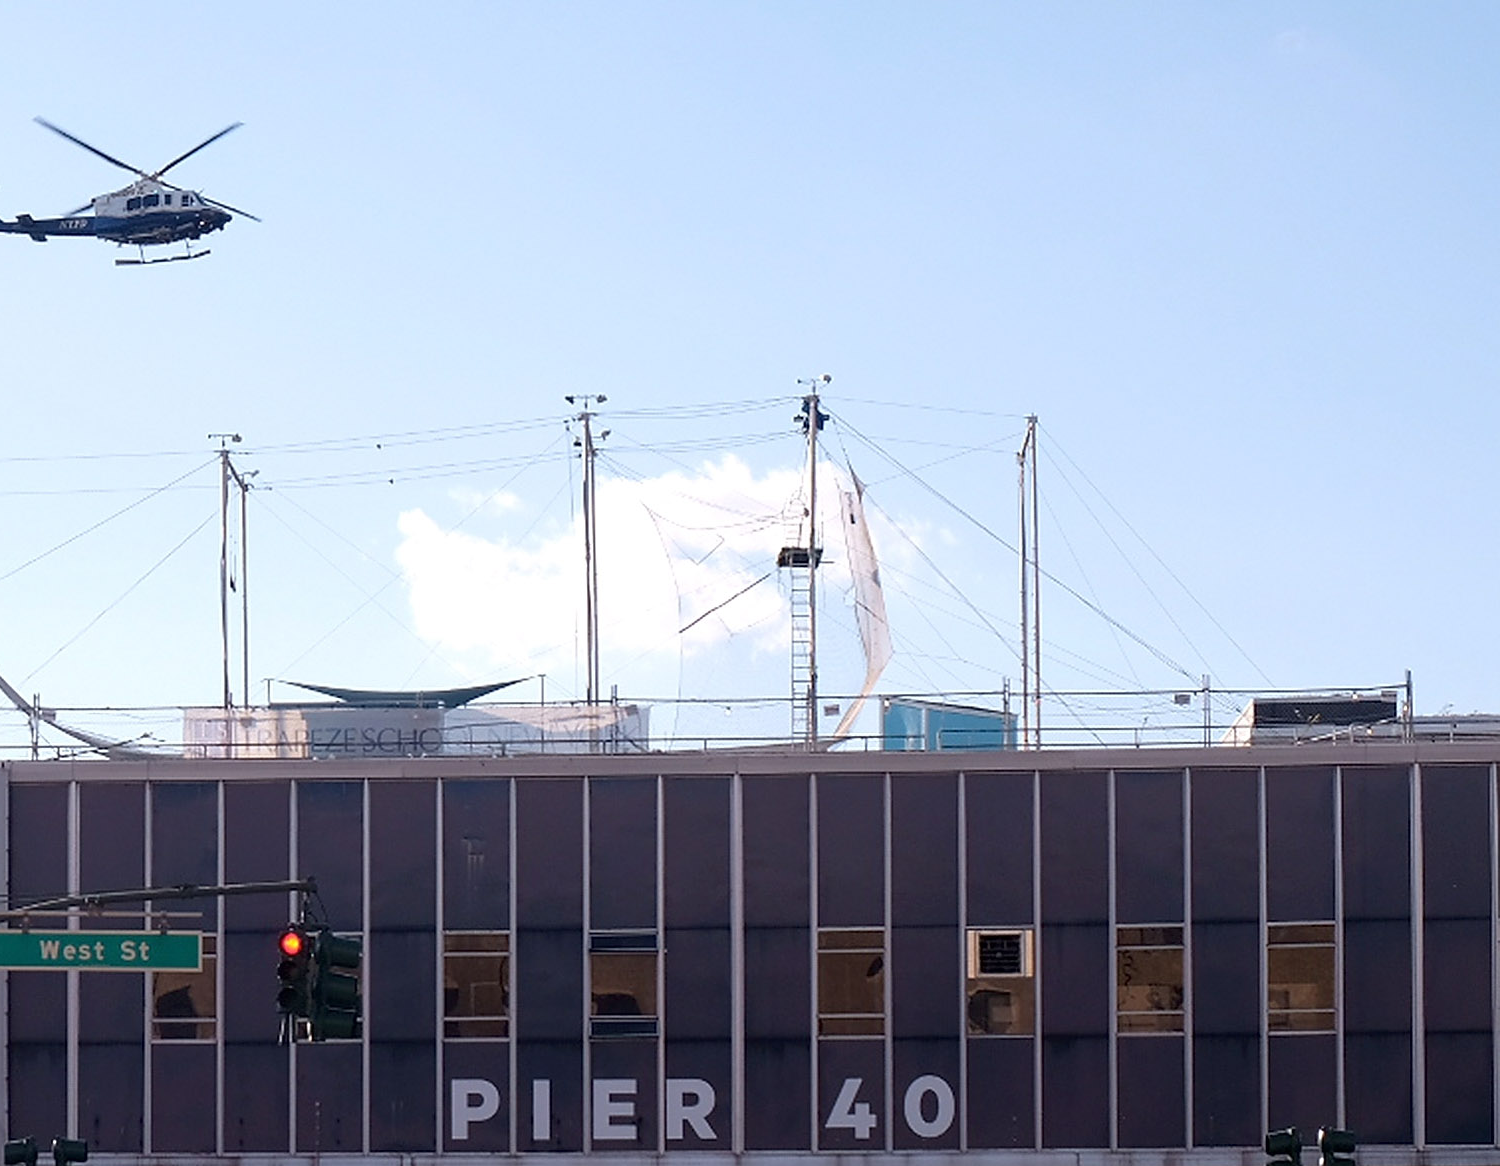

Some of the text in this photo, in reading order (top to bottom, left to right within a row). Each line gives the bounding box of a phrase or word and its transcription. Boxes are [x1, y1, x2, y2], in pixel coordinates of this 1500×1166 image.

[362, 727, 477, 753] SCHOL
[39, 940, 150, 961] West St
[450, 1074, 957, 1141] PIER 40
